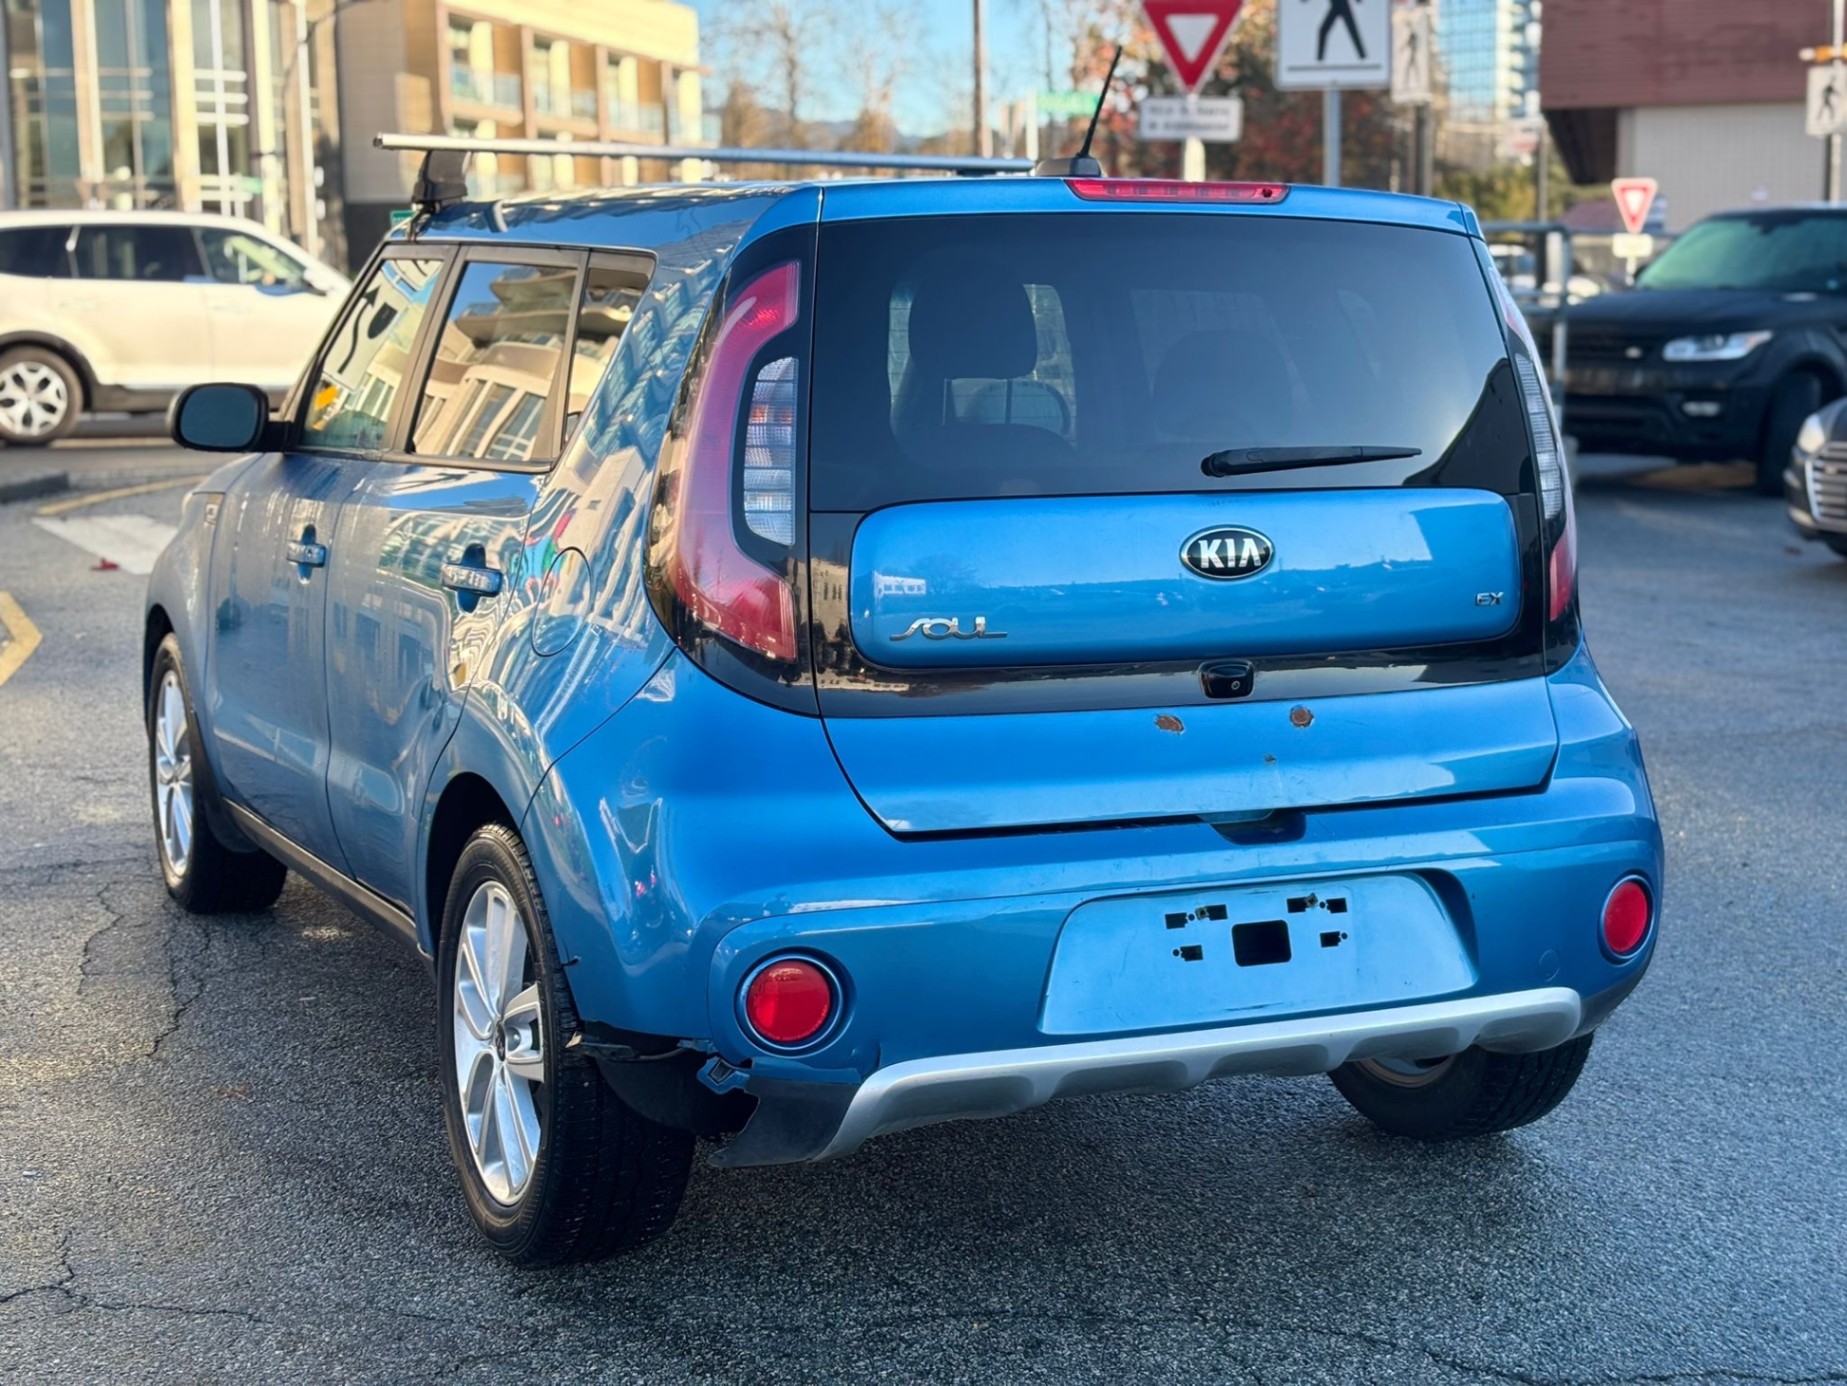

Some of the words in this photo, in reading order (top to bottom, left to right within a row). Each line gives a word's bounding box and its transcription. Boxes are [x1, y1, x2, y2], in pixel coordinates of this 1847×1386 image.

[1198, 538, 1262, 568] KIA
[1476, 591, 1503, 606] EX
[890, 616, 1008, 641] SOUL
